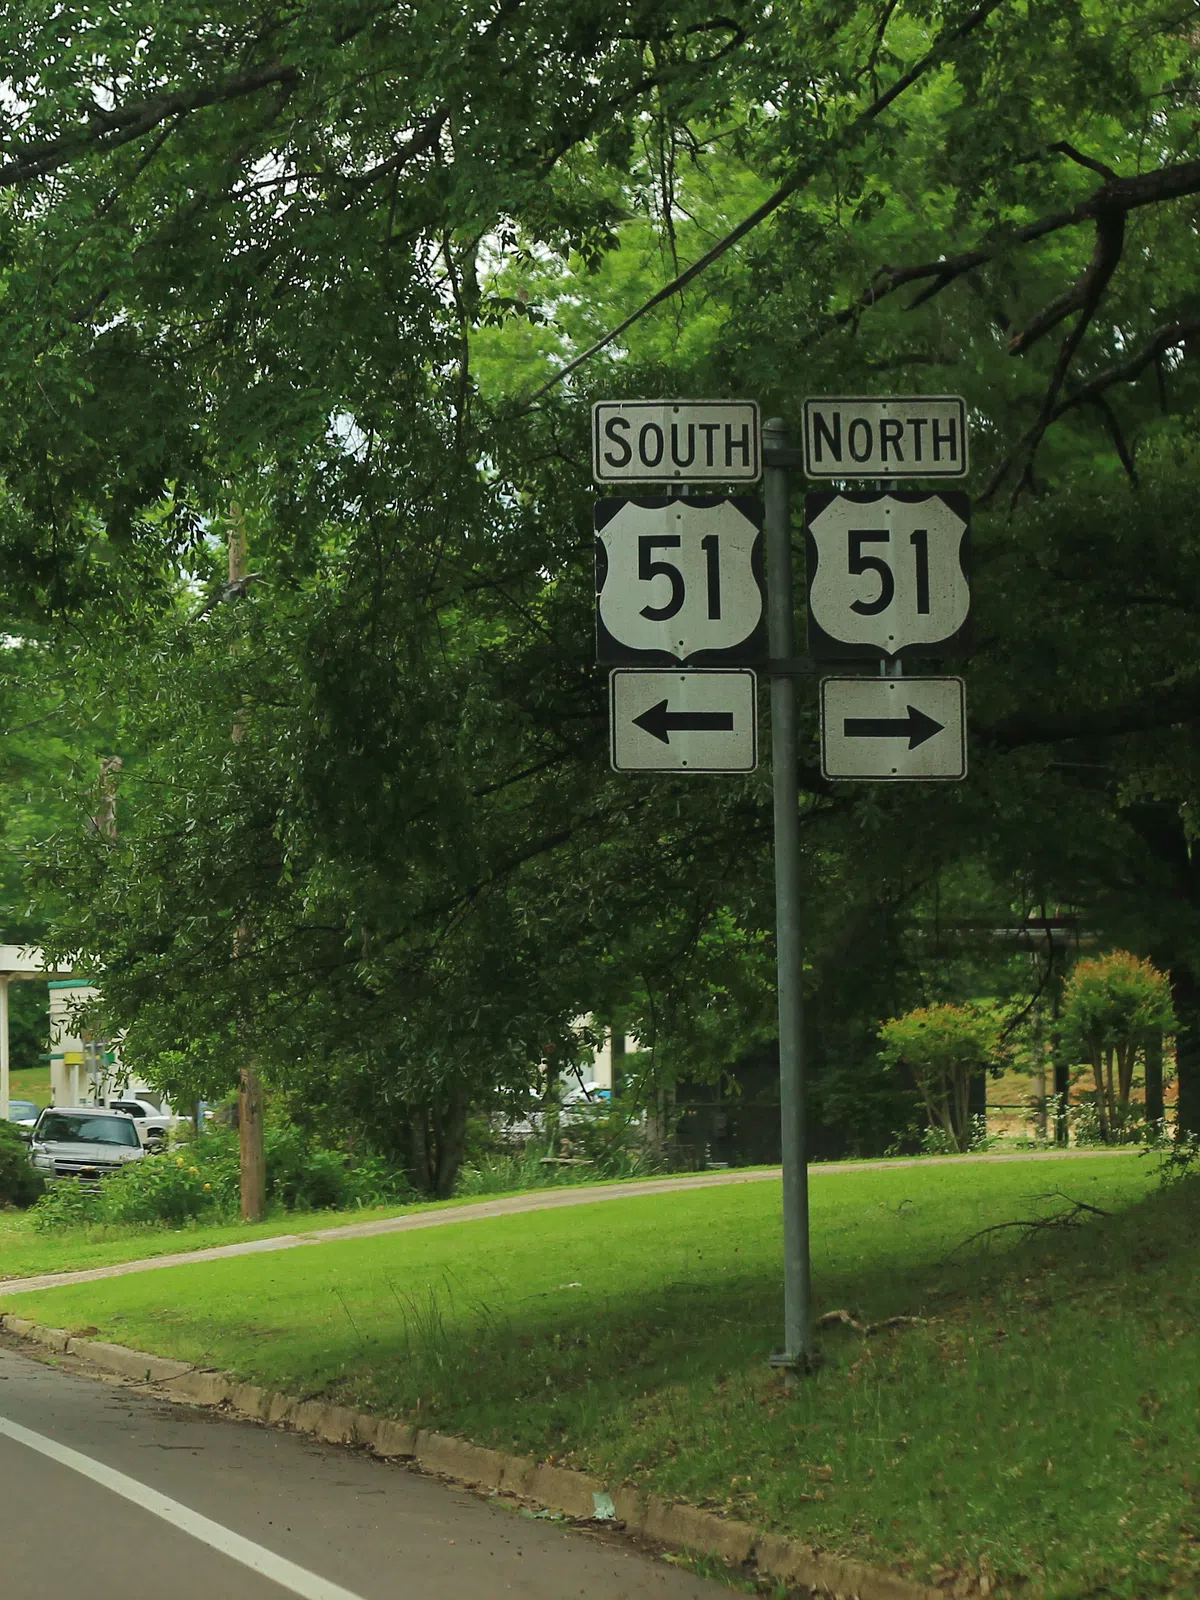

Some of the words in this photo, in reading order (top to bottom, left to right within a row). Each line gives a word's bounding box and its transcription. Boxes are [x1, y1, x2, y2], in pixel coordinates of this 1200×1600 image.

[604, 417, 750, 468] SOUTH
[812, 412, 957, 462] NORTH
[638, 535, 721, 621] 51
[847, 529, 929, 616] 51
